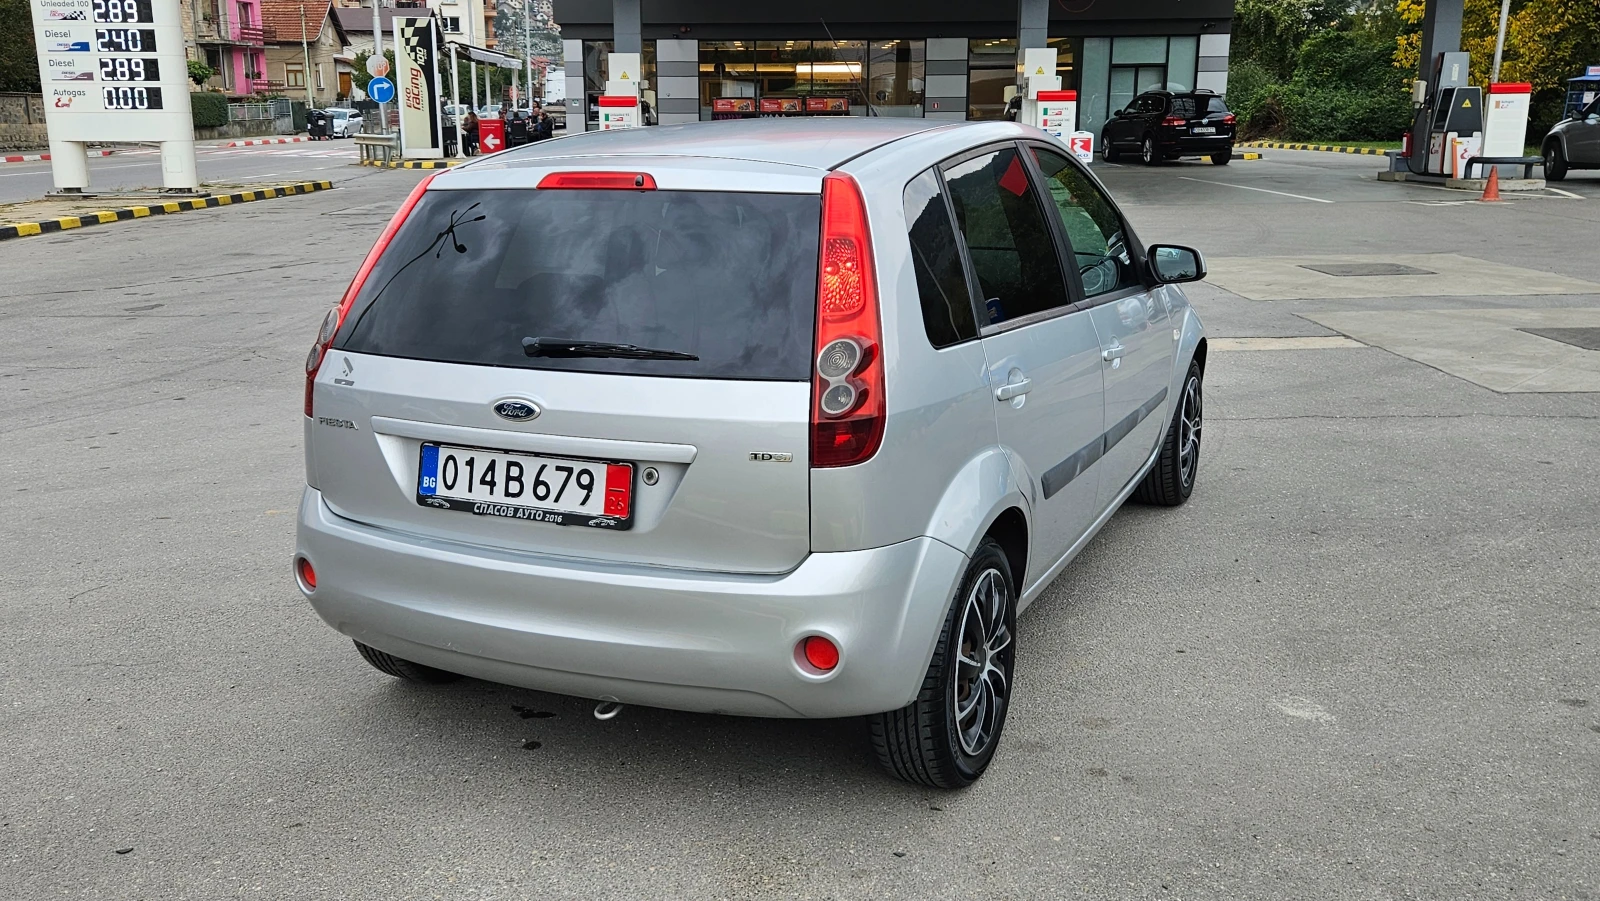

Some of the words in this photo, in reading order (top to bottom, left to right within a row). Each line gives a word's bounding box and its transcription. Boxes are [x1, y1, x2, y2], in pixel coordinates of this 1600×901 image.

[93, 0, 138, 22] 2.89
[44, 30, 71, 38] Diesel
[97, 29, 142, 51] 2.40
[48, 59, 75, 67] Diesel
[416, 46, 426, 66] 100
[101, 59, 145, 80] 2.89
[53, 88, 86, 98] Autogas
[104, 87, 148, 109] 0.00
[410, 67, 422, 111] racing
[500, 402, 527, 417] Ford
[318, 416, 359, 431] FIESTA
[422, 476, 436, 489] BG
[441, 453, 596, 508] 014B679
[473, 502, 514, 517] СПАСОВ
[516, 508, 544, 522] АУТО
[544, 513, 563, 523] 2016
